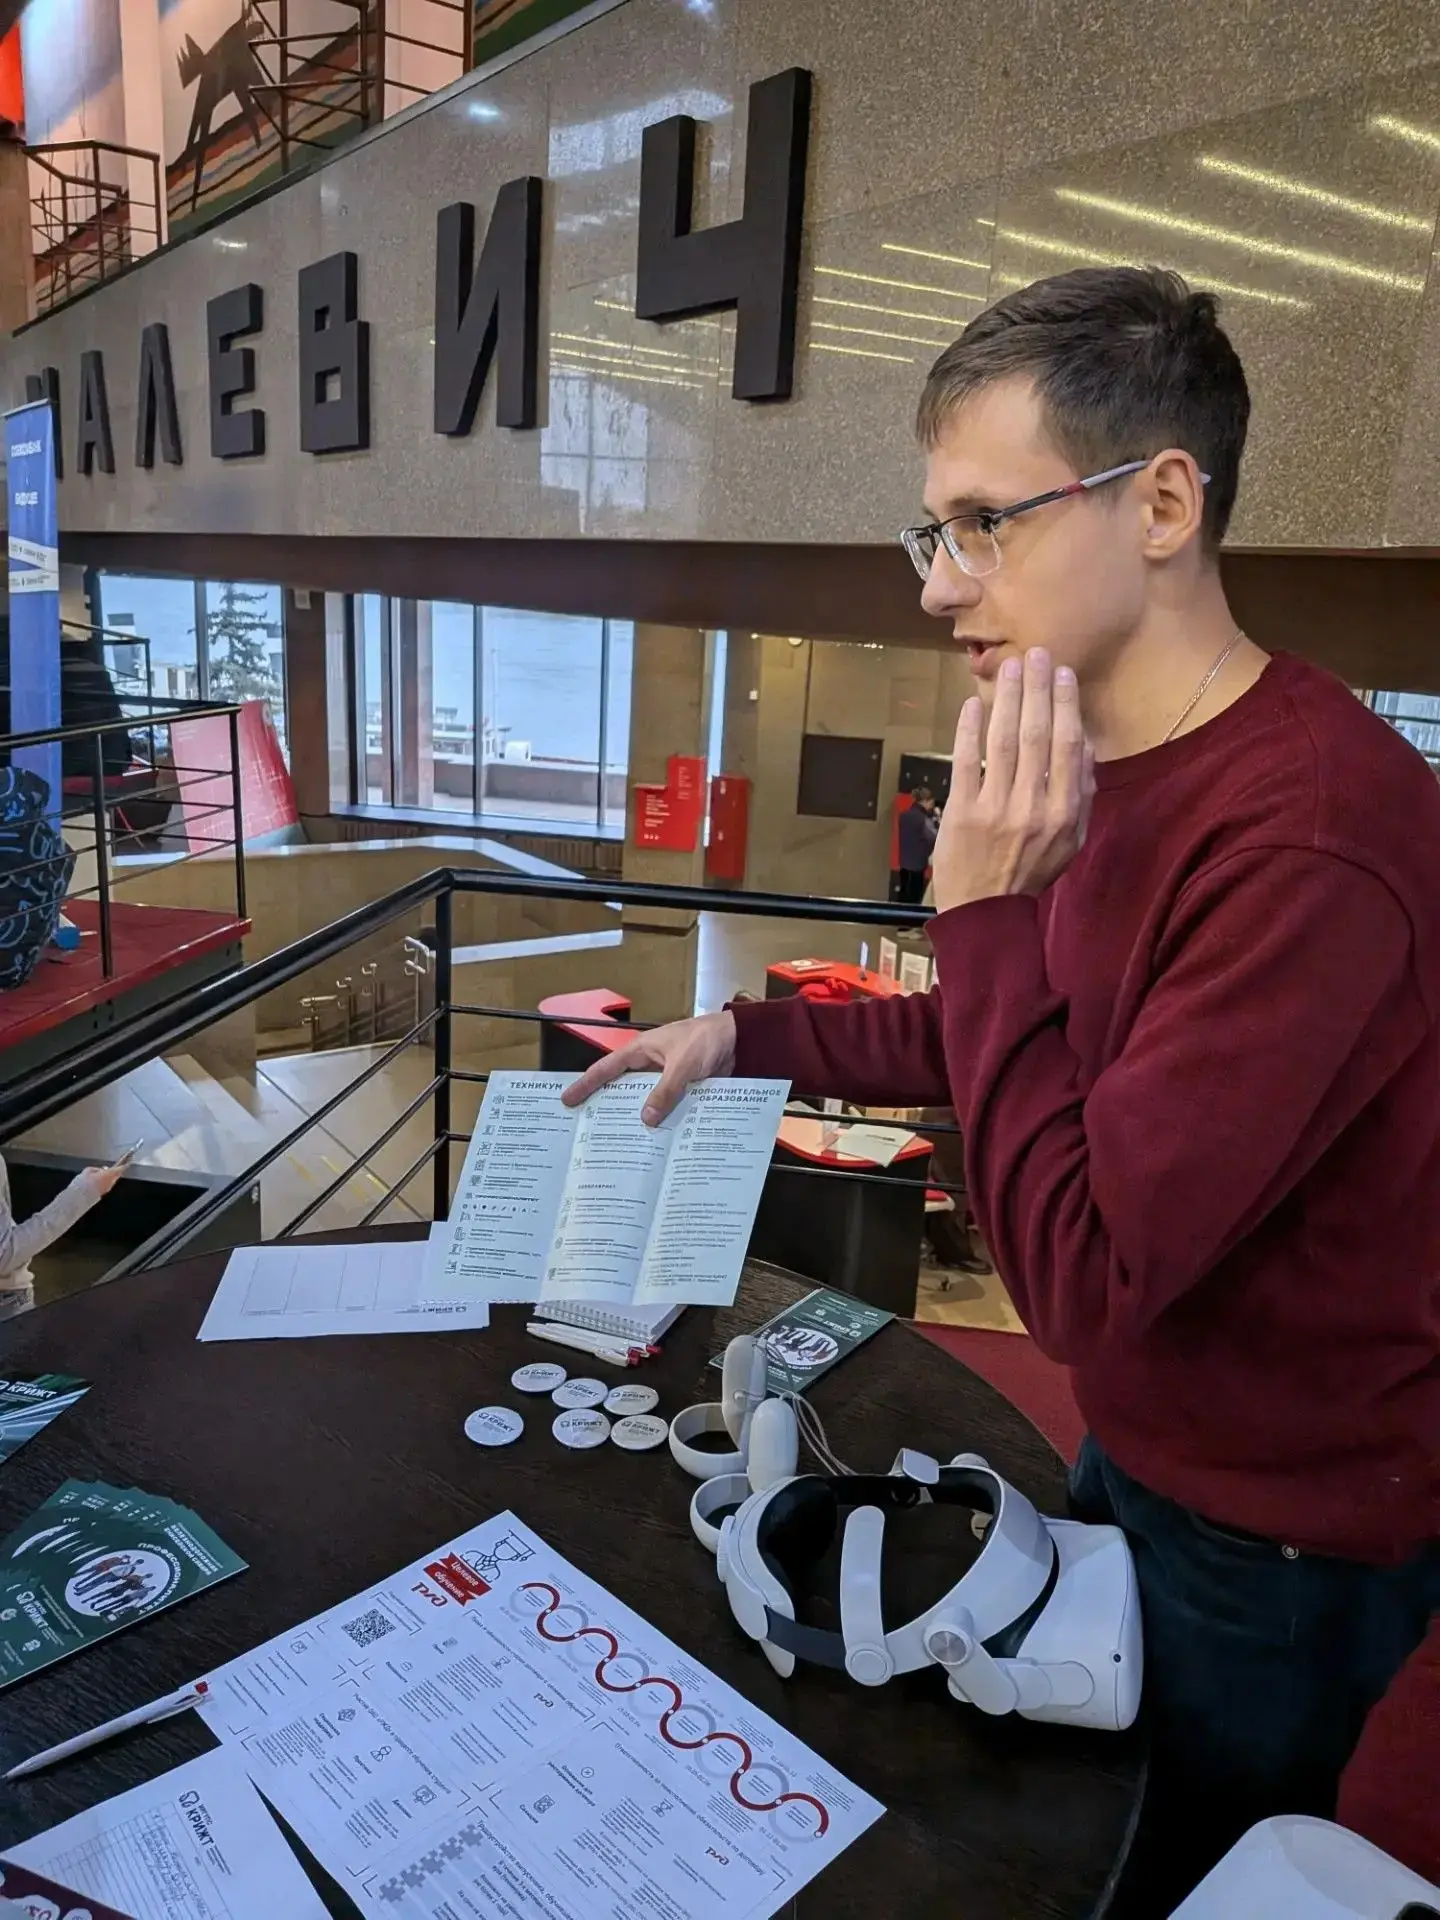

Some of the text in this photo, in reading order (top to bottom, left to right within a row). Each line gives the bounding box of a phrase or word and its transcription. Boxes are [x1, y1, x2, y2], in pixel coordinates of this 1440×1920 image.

[510, 1081, 563, 1090] ТЕХНИКУМ
[603, 1081, 655, 1090] ИНСТИТУТ
[690, 1087, 782, 1097] ДОПОЛНИТЕЛЬНОЕ
[699, 1095, 769, 1103] ОБРАЗОВАНИЕ
[8, 1384, 57, 1398] КРИЖТ
[488, 1417, 516, 1433] КРИЖТ
[451, 1561, 479, 1587] Целевое
[434, 1570, 465, 1599] обучение
[186, 1808, 214, 1846] КРИЖТ
[476, 1820, 516, 1862] Трудоустройство
